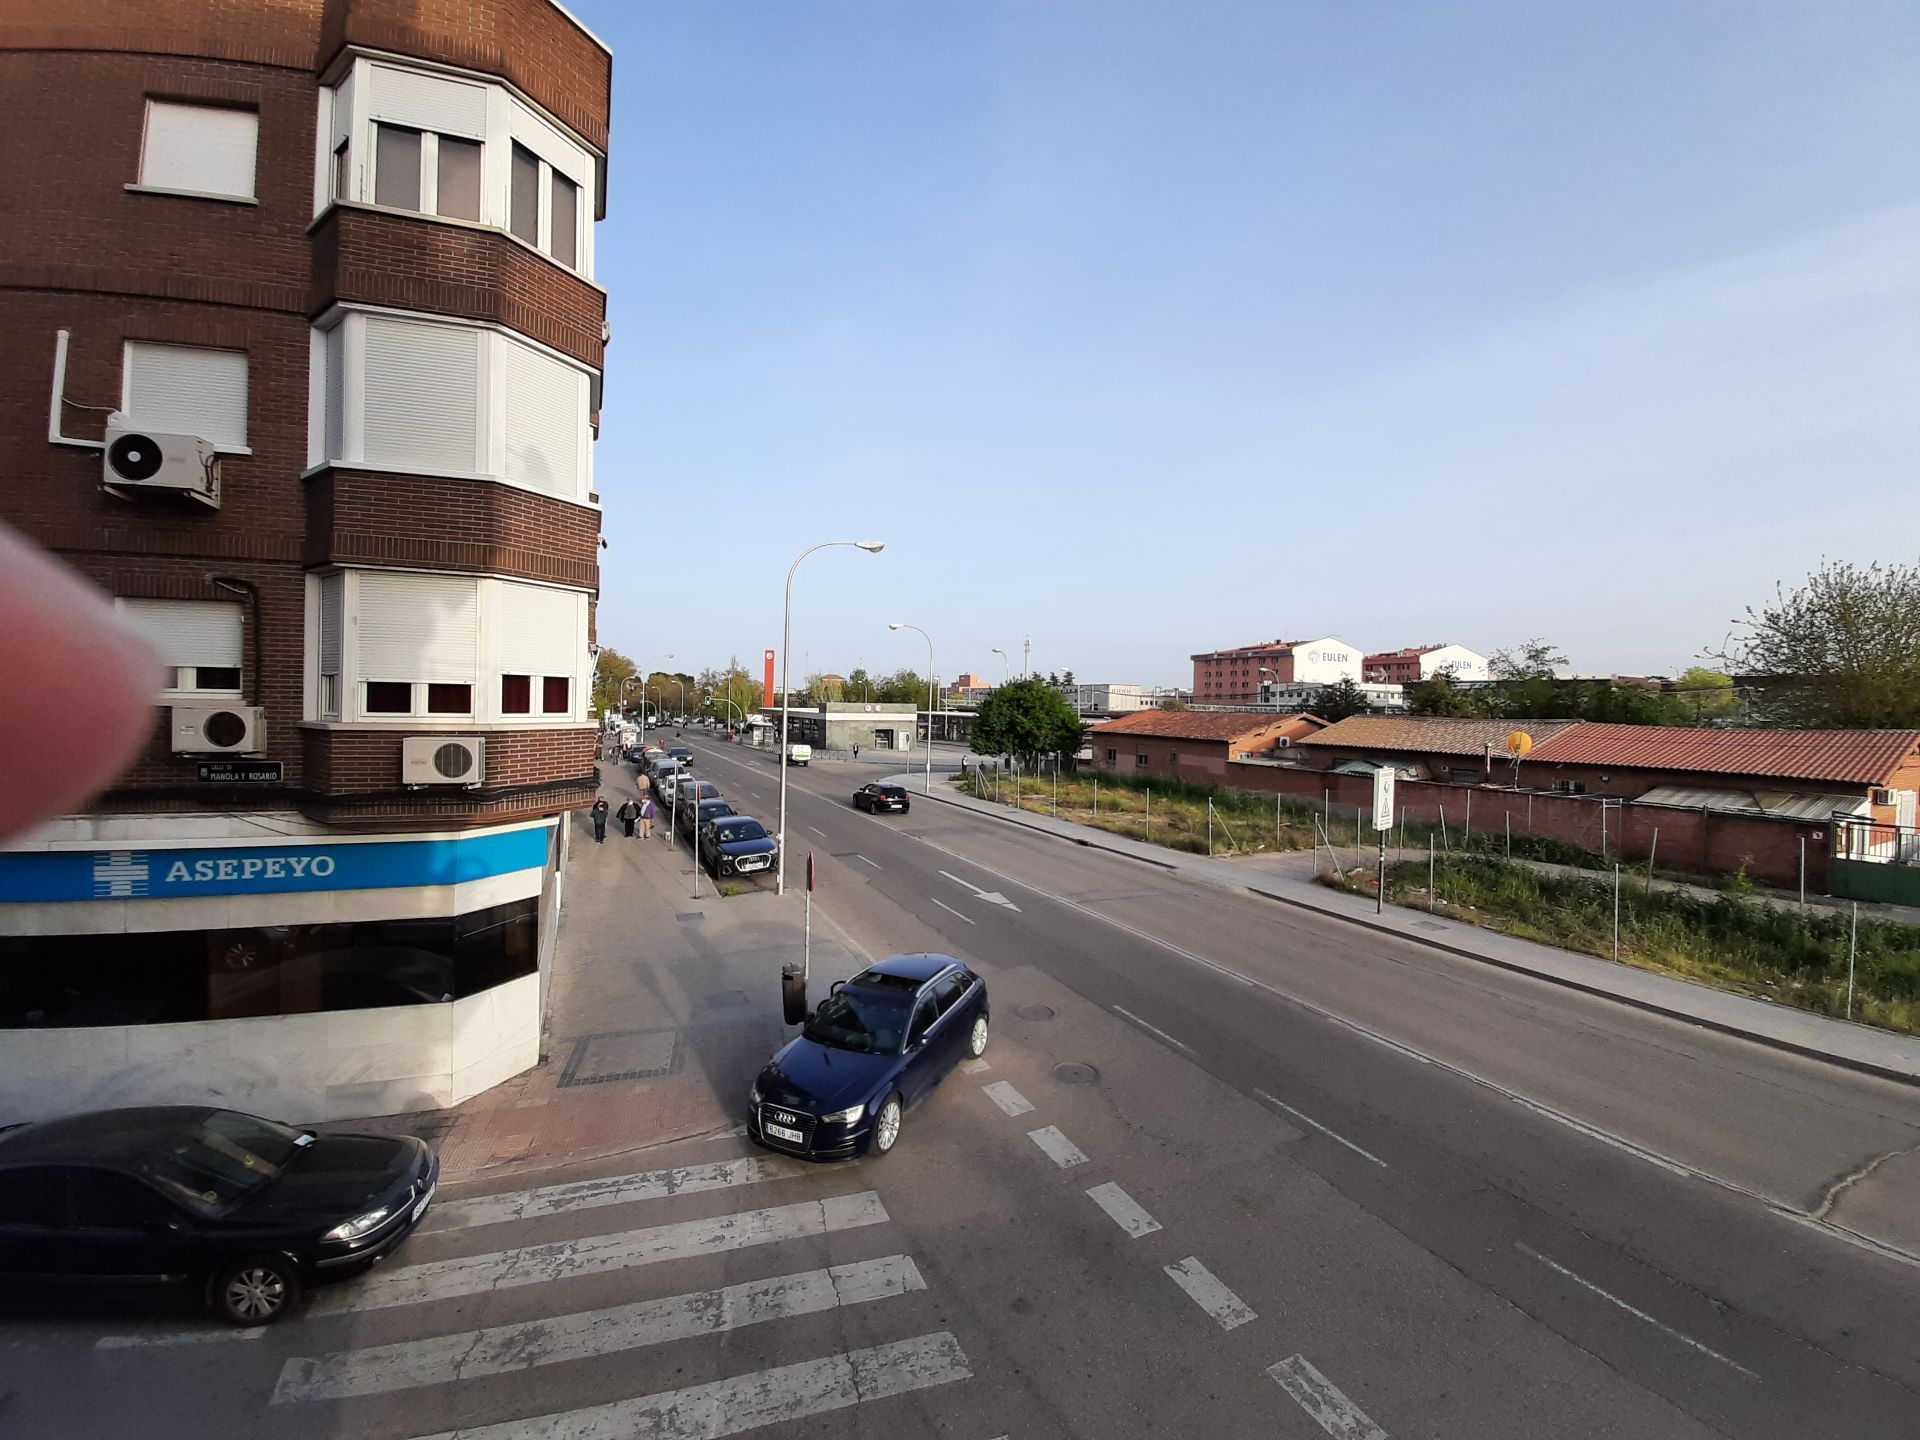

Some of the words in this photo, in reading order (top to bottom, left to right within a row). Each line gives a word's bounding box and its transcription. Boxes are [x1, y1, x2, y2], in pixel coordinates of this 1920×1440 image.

[1322, 652, 1348, 662] EULEN
[210, 772, 239, 780] MANOLA
[241, 772, 246, 780] Y
[248, 772, 277, 780] ROSARIO
[165, 855, 335, 882] ASEPEYO
